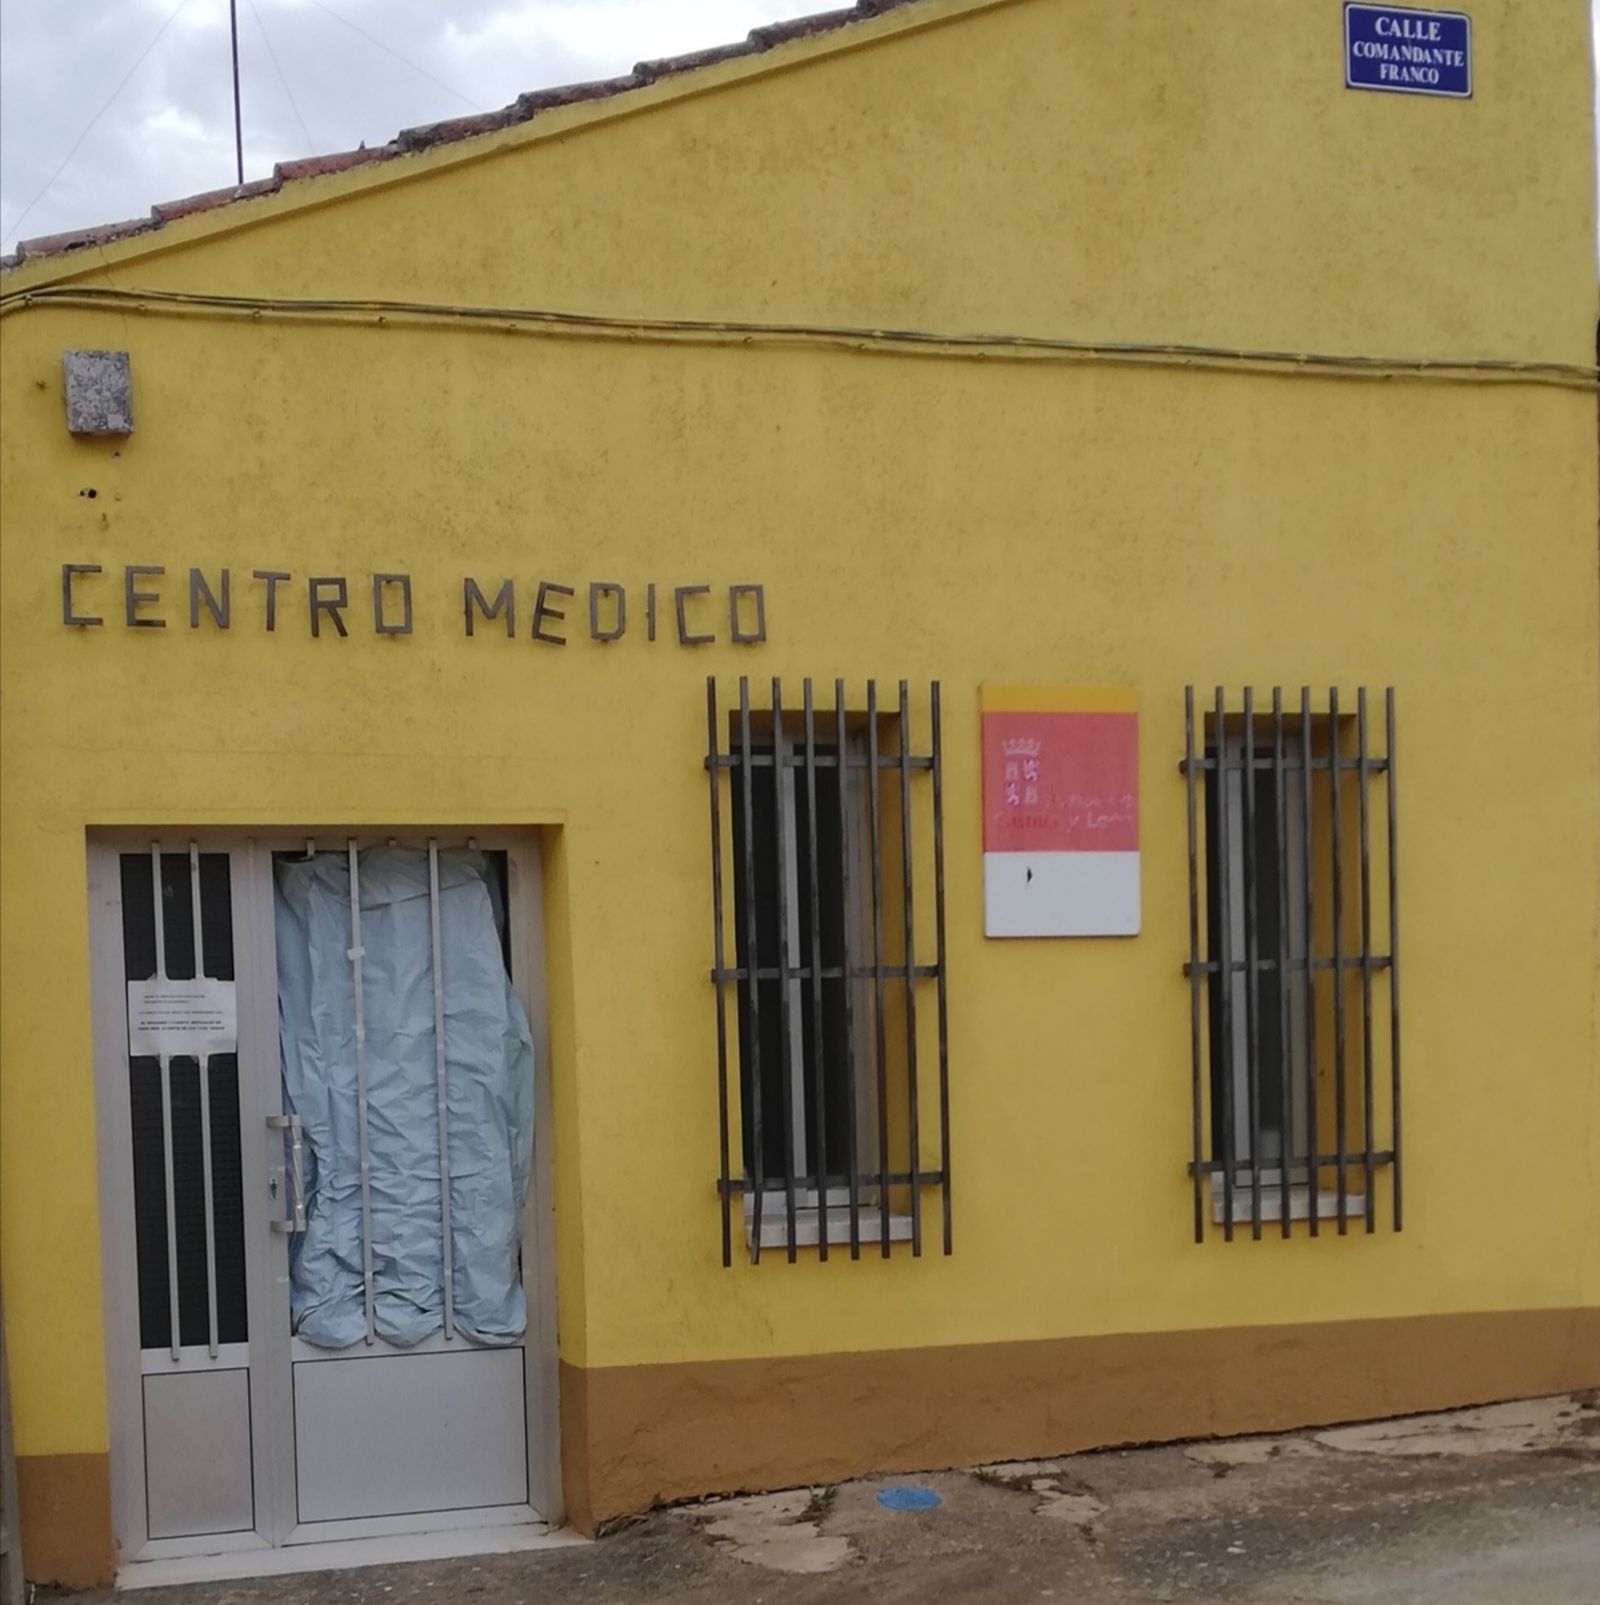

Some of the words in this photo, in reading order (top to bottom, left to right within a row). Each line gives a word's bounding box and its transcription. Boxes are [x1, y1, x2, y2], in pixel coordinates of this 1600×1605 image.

[1375, 16, 1441, 41] CALLE
[1353, 40, 1464, 67] COMANDANTE
[1380, 63, 1439, 84] FRANCO
[62, 564, 413, 636] CENTRO
[463, 576, 768, 646] MEDICO
